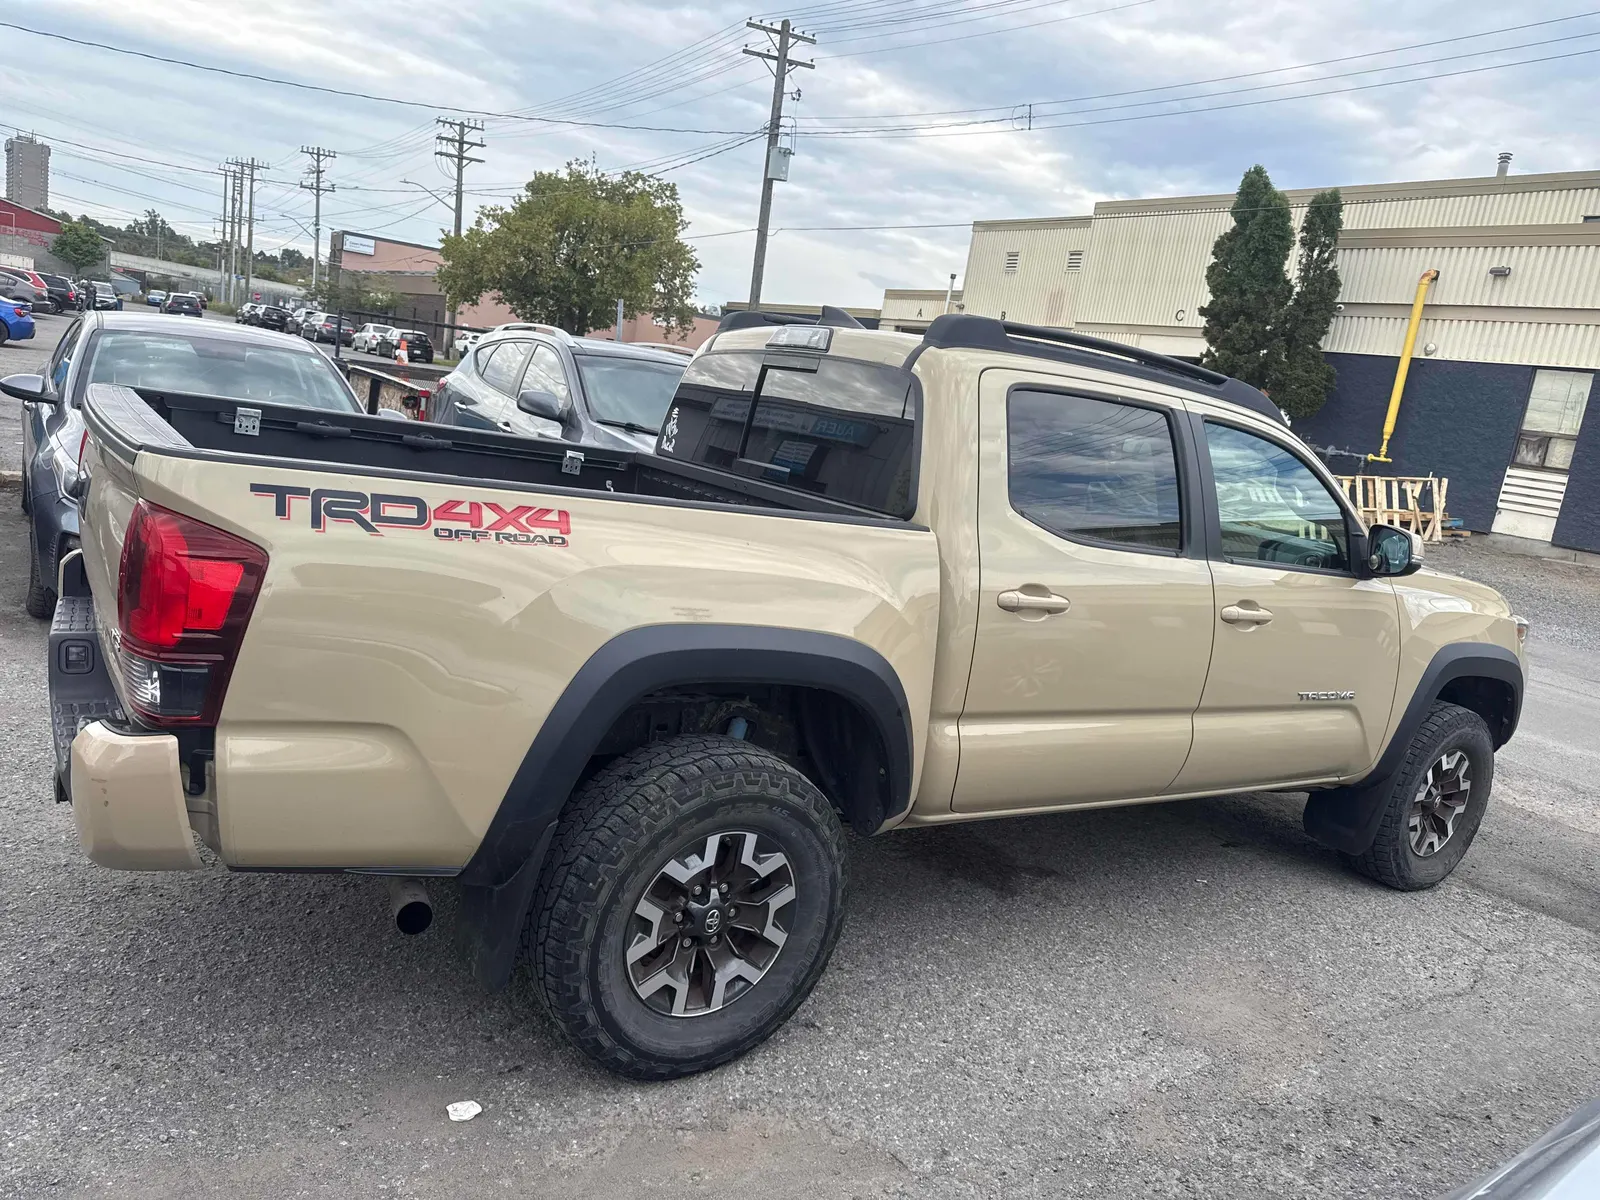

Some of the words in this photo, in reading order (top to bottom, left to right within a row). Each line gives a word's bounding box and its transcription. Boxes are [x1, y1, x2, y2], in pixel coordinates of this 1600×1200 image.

[917, 308, 923, 318] A
[1175, 309, 1185, 322] C
[250, 482, 432, 536] TRD
[433, 527, 492, 543] OFF
[494, 531, 570, 548] ROAD
